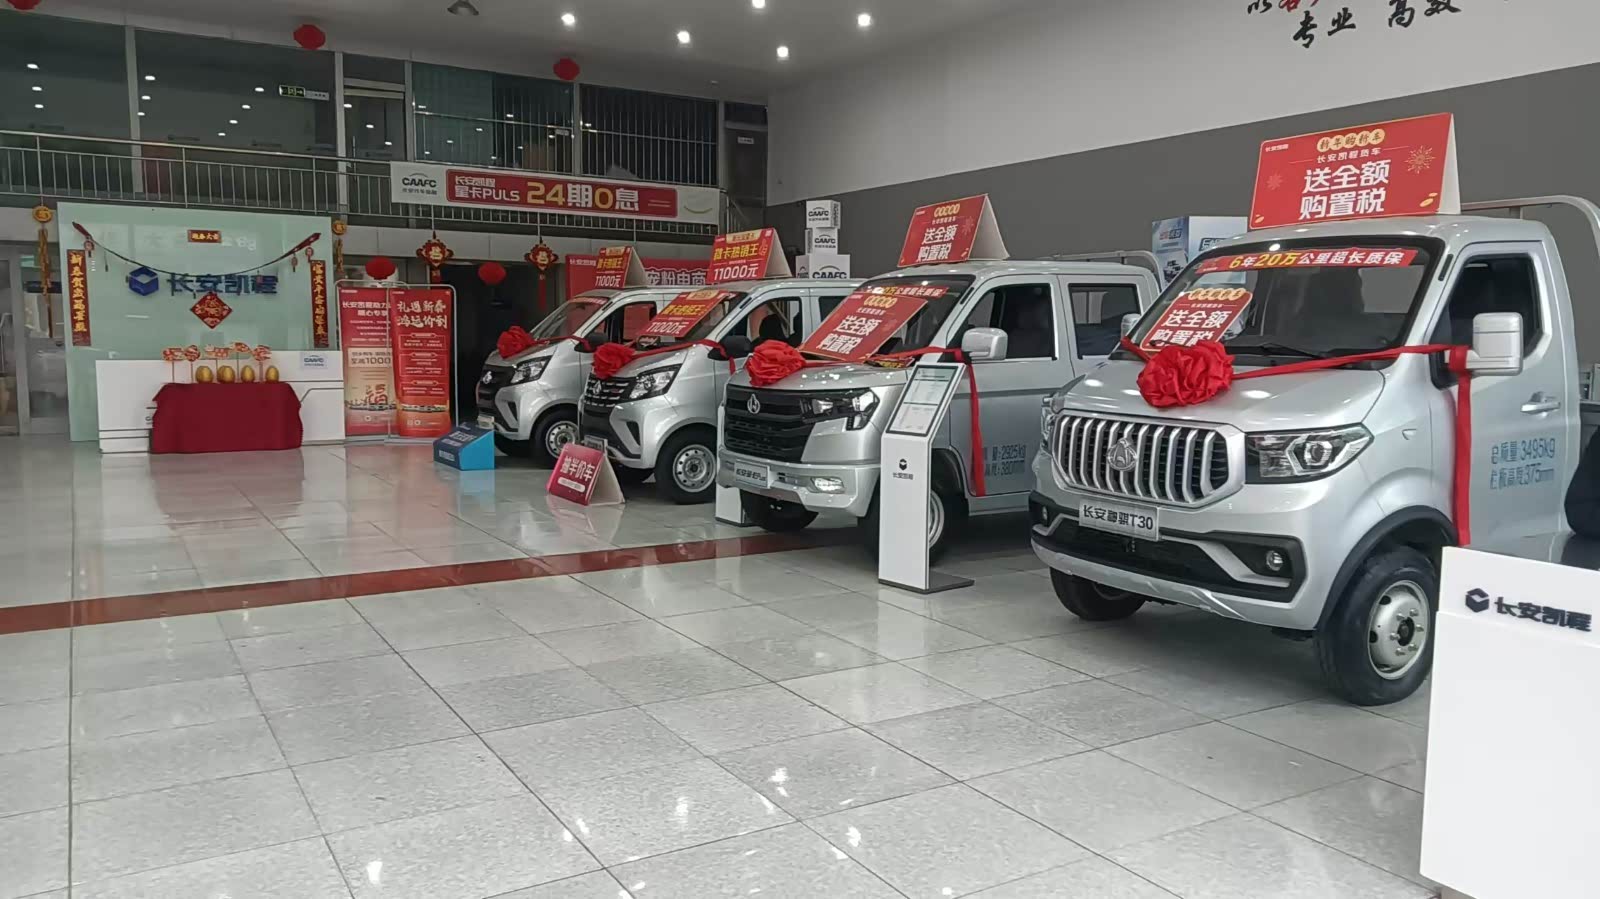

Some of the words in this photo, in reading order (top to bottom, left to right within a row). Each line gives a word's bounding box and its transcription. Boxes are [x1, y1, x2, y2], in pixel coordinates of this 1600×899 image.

[1293, 7, 1356, 48] 专业
[1317, 130, 1384, 151] 新年购新车
[1317, 147, 1381, 164] 长安凯程货车
[402, 177, 437, 188] CAAFC
[455, 175, 496, 188] 长安凯程
[1302, 159, 1391, 194] 送全额
[454, 185, 520, 202] 星卡PULS
[527, 181, 640, 212] 24期0息
[1298, 187, 1386, 221] 购置税
[808, 209, 829, 217] CAAFC
[922, 224, 958, 245] 送全额
[916, 243, 952, 262] 购置税
[1229, 250, 1405, 269] 6年20万公里超长质保
[713, 263, 760, 281] 11000元
[166, 272, 279, 297] 长安凯程
[834, 315, 883, 337] 送全额
[1161, 309, 1232, 330] 送全额
[818, 333, 863, 355] 购置税
[1494, 597, 1592, 632] 长安凯程
